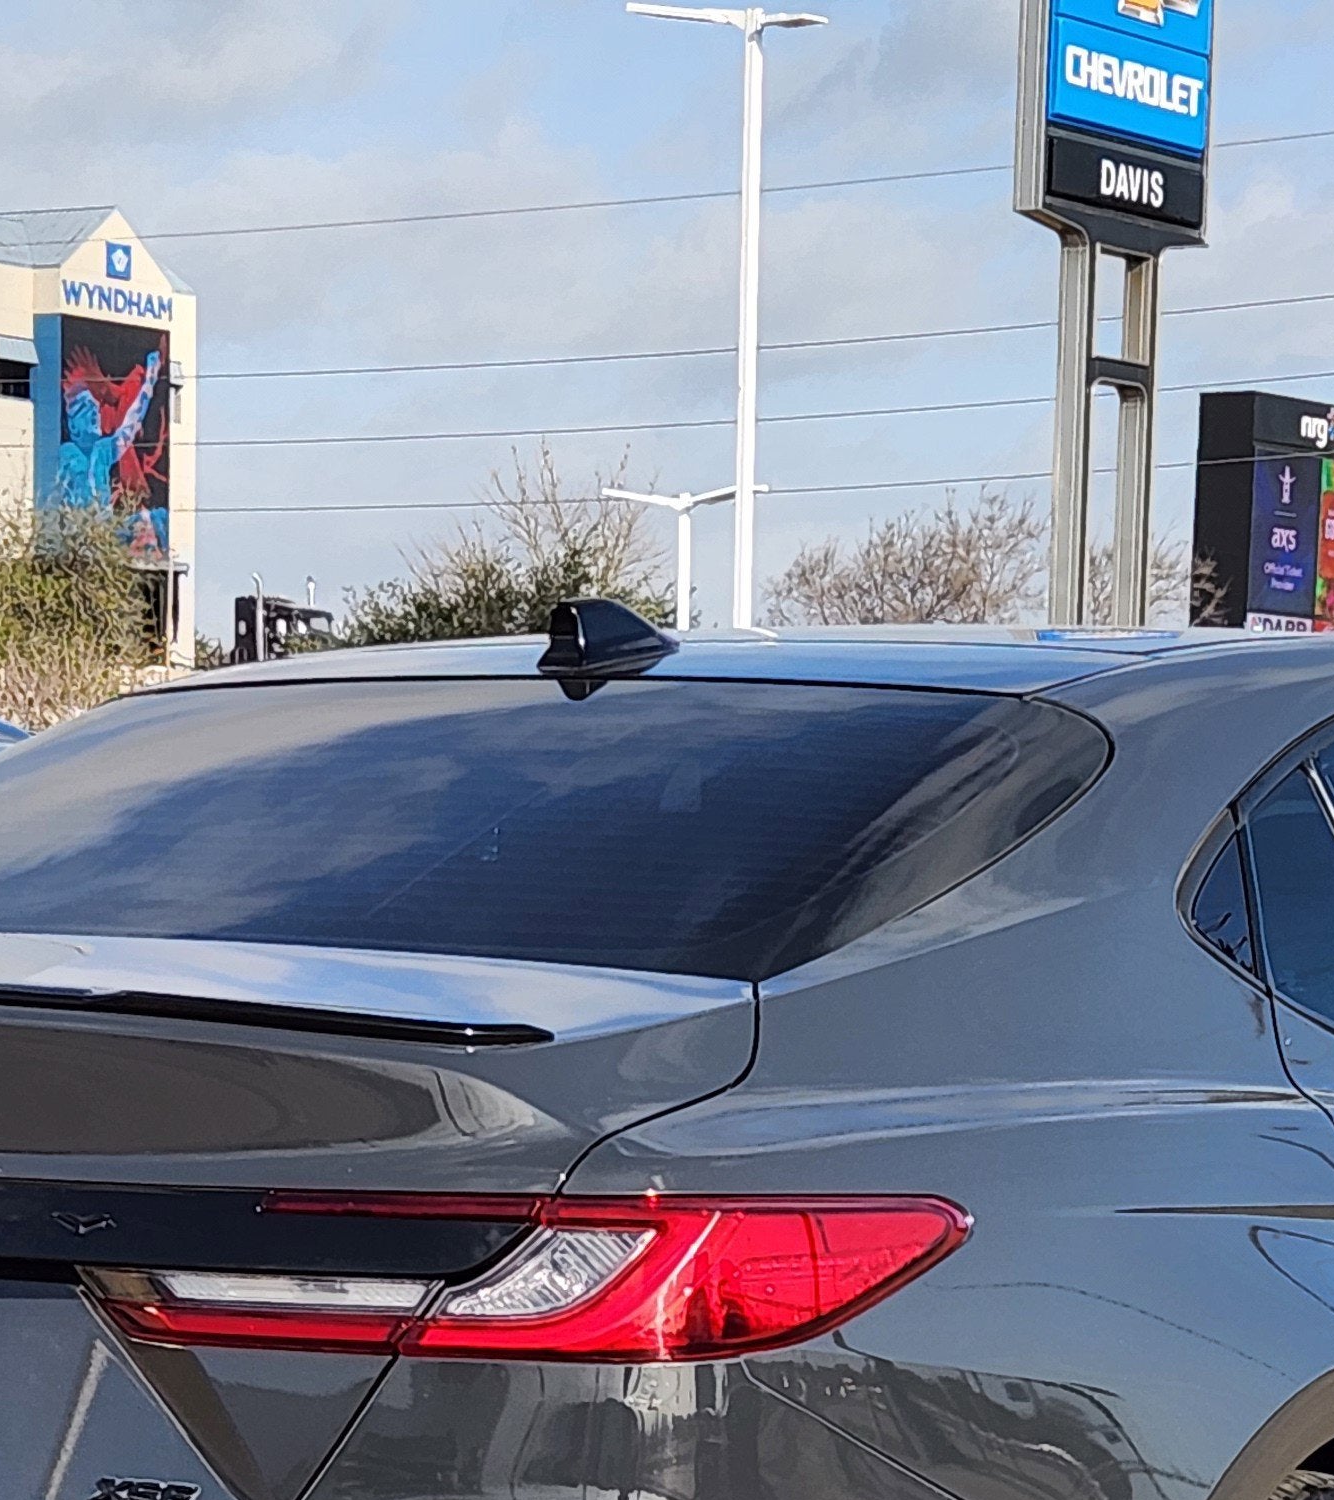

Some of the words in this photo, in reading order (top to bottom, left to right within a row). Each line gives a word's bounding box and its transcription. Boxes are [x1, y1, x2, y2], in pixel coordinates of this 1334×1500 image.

[1065, 44, 1204, 118] CHEVROLET
[1099, 158, 1164, 209] DAVIS
[62, 279, 173, 322] WYNDHAM
[1300, 415, 1329, 449] nrg
[1271, 527, 1297, 553] axs
